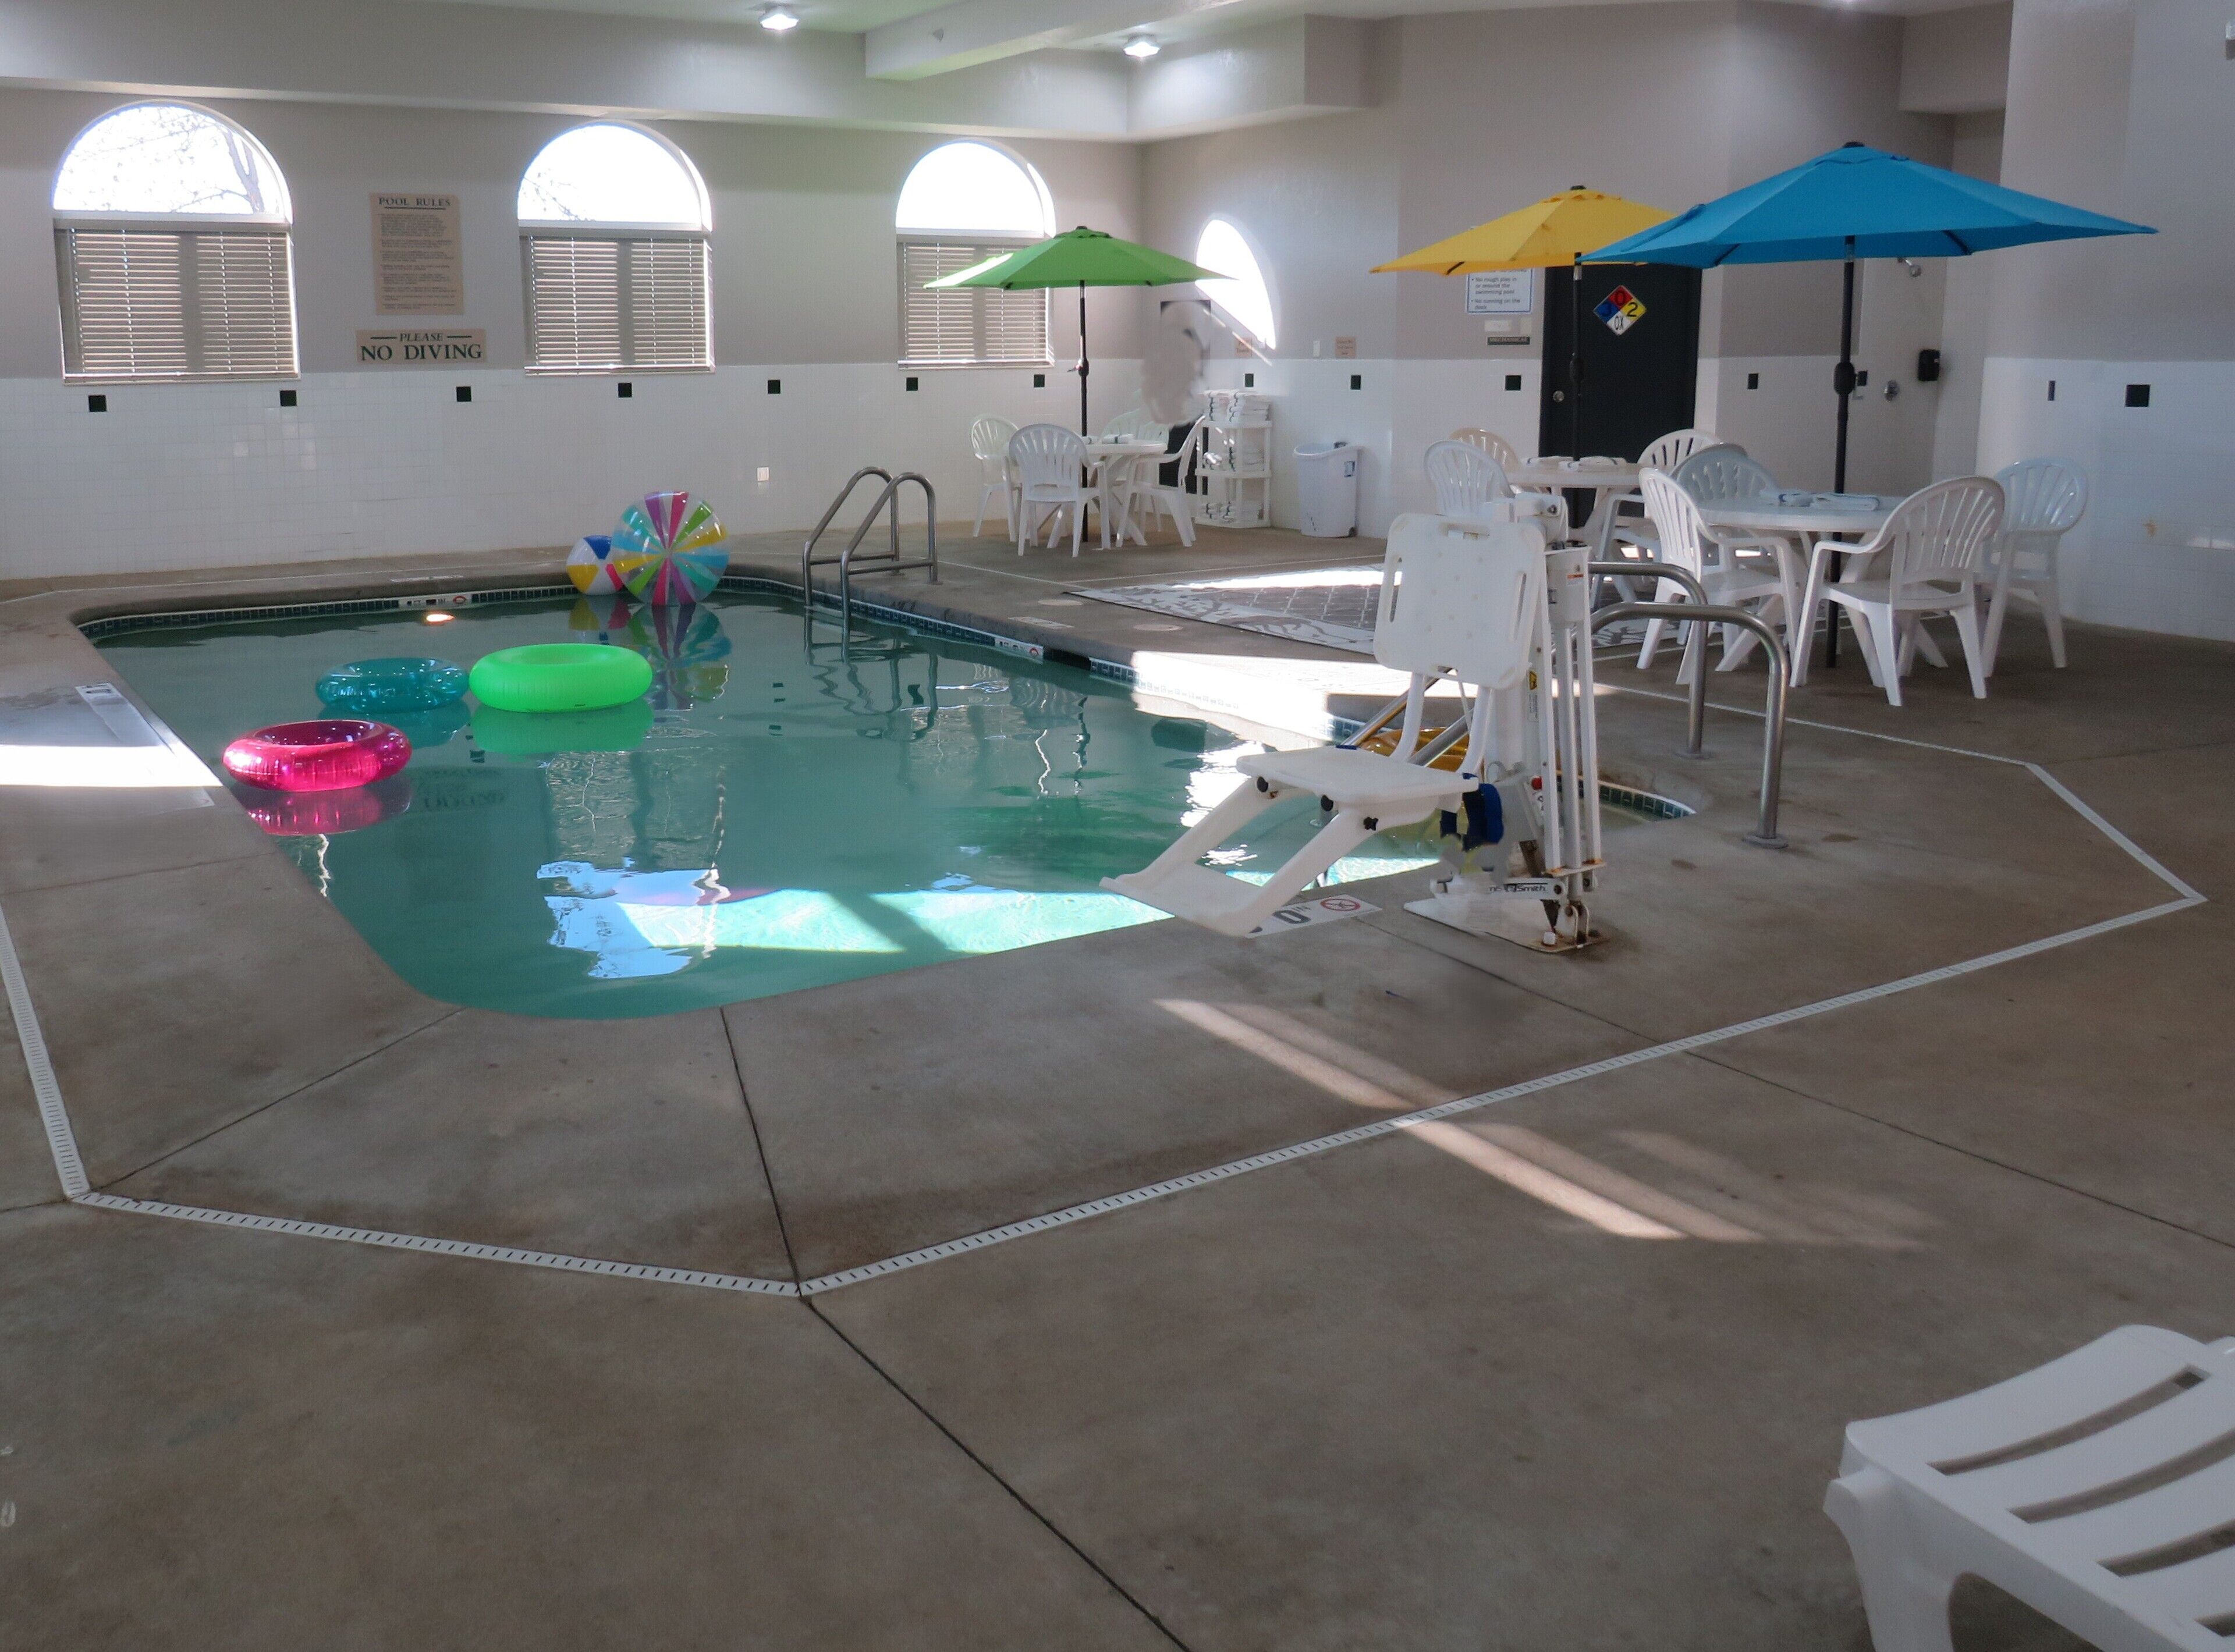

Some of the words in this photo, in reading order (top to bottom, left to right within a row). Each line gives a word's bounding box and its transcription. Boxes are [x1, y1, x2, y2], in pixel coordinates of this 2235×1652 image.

[416, 198, 452, 207] RULES
[1627, 302, 1638, 317] 2
[399, 333, 444, 342] PLEASE
[360, 344, 393, 361] NO
[404, 343, 483, 360] DIVING
